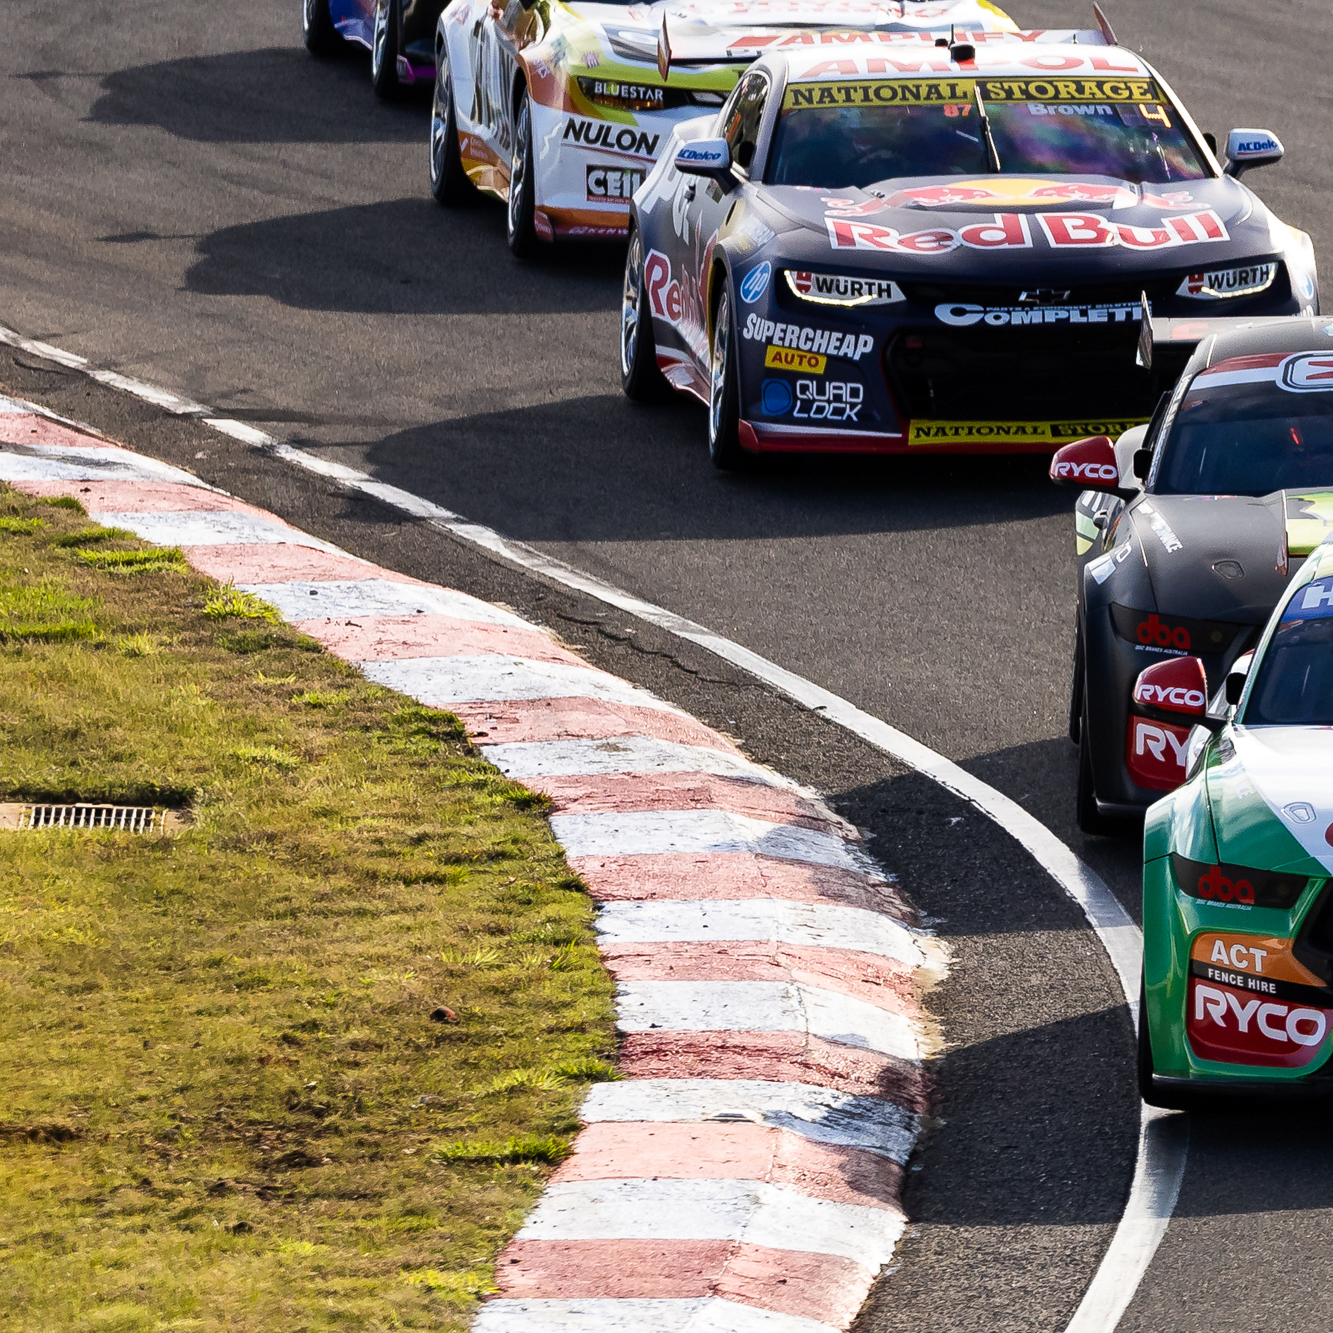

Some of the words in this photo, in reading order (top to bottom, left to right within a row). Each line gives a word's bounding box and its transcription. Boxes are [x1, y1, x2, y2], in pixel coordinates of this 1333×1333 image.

[594, 80, 664, 102] BLUESTAR
[791, 80, 972, 106] NATIONAL
[986, 78, 1154, 101] STORAGE
[943, 104, 972, 118] 87
[1027, 102, 1114, 117] Brown
[562, 117, 661, 156] NULON
[825, 211, 1032, 253] Red
[1034, 209, 1230, 253] Bull
[815, 276, 893, 300] WÜRTH
[743, 312, 874, 361] SUPERCHEAP
[771, 350, 820, 369] AUTO
[796, 380, 864, 403] QUAD
[792, 402, 862, 422] LOCK
[913, 421, 1047, 440] NATIONAL
[1054, 461, 1118, 480] RYCO
[1136, 614, 1191, 650] dba
[1136, 684, 1205, 707] RYCO
[1135, 722, 1188, 767] RY
[1198, 865, 1255, 905] dba
[1210, 939, 1268, 973] ACT
[1208, 968, 1245, 989] FENCE
[1248, 976, 1277, 994] HIRE
[1194, 984, 1327, 1046] RYCO
